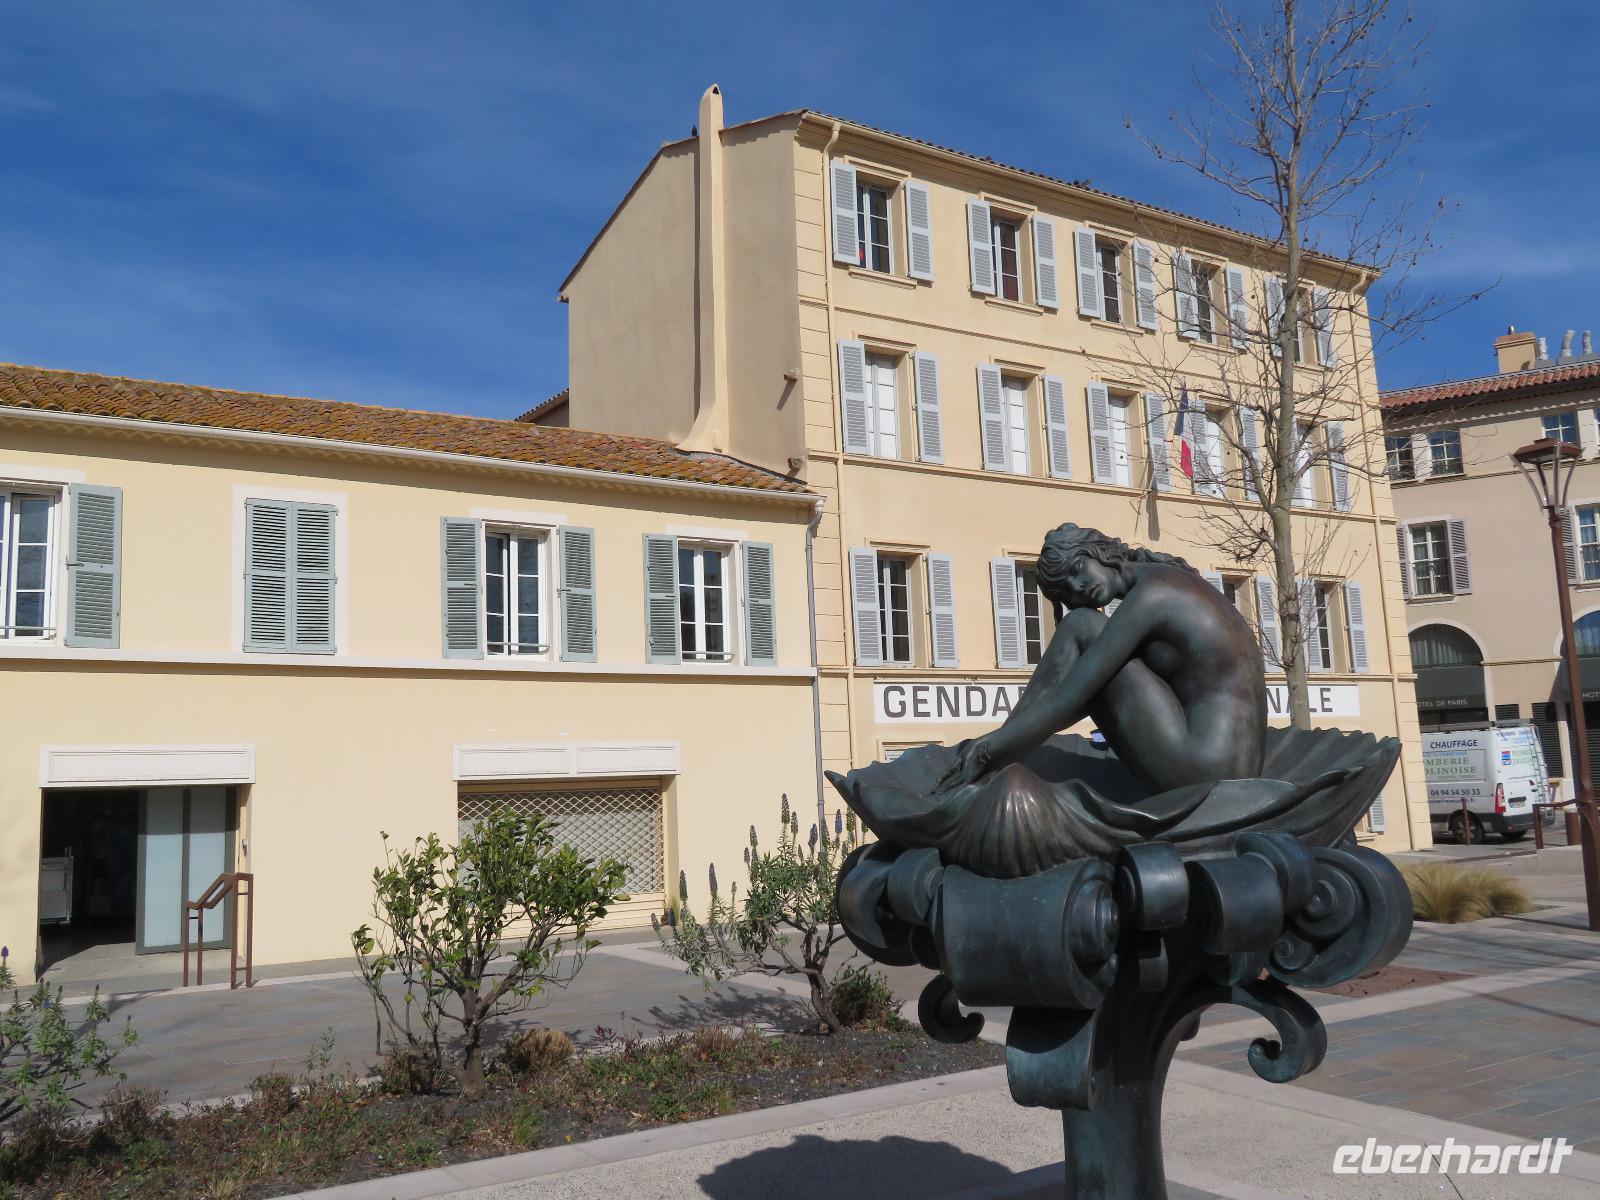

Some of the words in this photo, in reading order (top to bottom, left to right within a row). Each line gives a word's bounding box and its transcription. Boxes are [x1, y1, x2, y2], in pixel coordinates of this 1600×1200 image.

[883, 685, 1027, 719] GENDA
[1430, 739, 1478, 749] CHAUFFAGE
[1430, 789, 1439, 797] 04
[1440, 789, 1450, 797] 94
[1461, 788, 1470, 796] 50
[1471, 788, 1481, 796] 33
